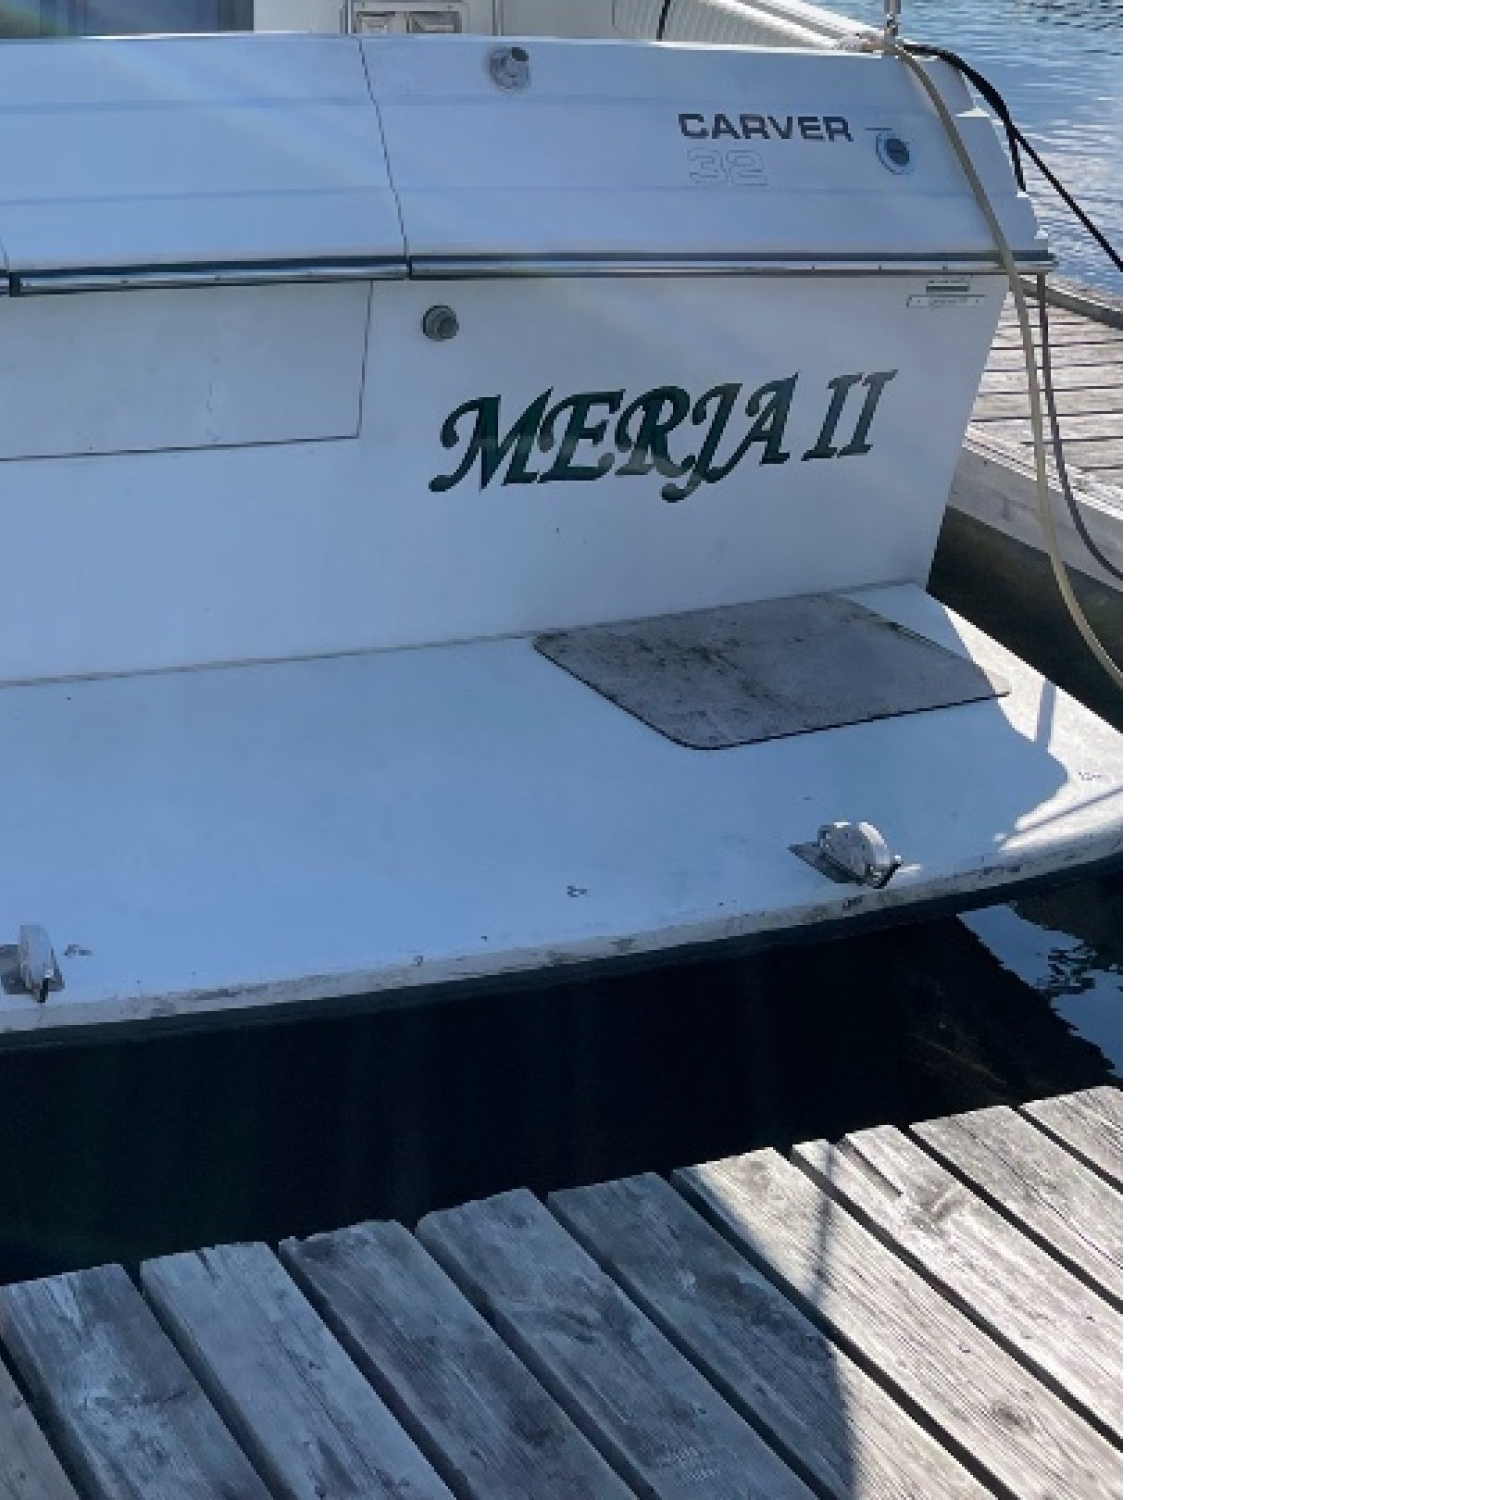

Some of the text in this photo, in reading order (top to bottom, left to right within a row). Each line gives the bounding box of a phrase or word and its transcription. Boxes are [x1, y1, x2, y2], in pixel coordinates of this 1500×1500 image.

[678, 113, 854, 143] CARVER
[686, 149, 768, 186] 32
[428, 369, 899, 503] MERJA II
